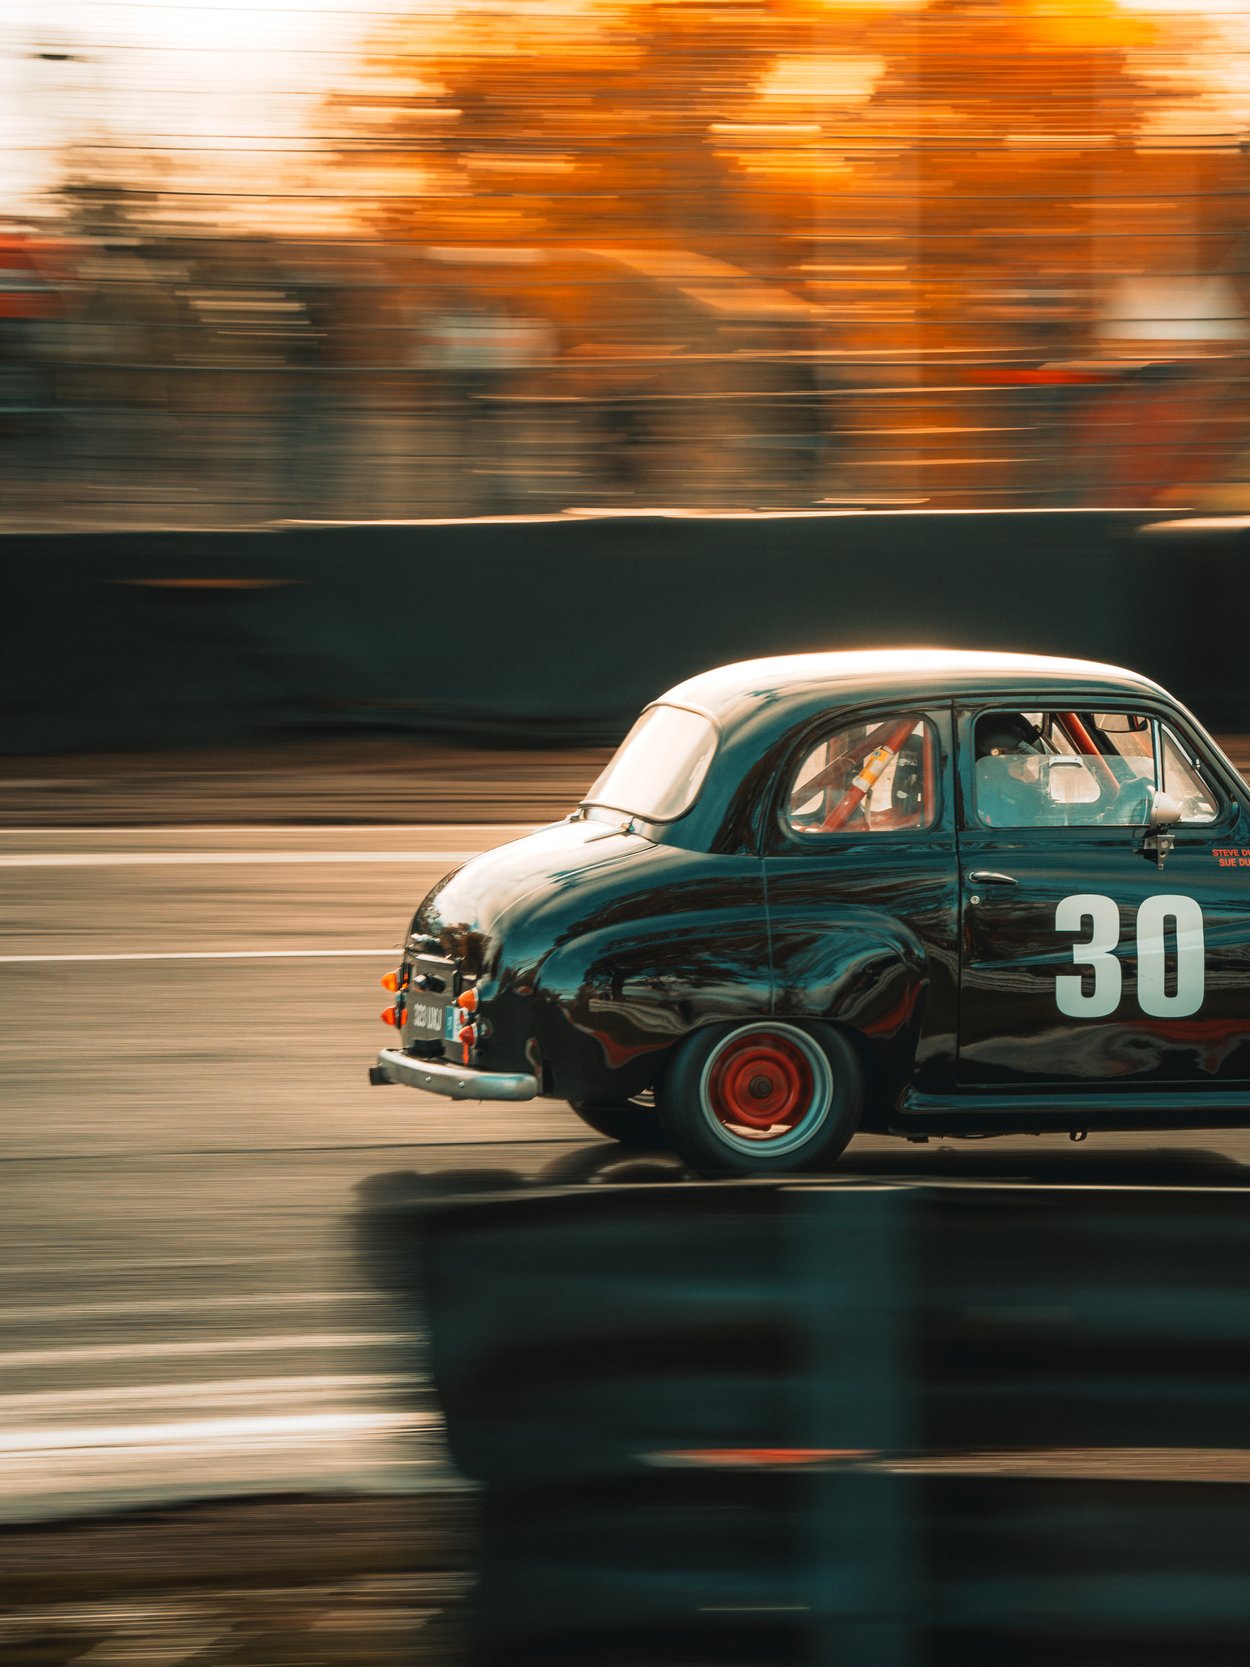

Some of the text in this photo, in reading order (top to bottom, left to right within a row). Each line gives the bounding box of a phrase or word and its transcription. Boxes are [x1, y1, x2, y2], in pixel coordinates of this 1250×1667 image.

[1212, 849, 1240, 857] STEVE
[1219, 858, 1237, 867] SUE
[1055, 894, 1205, 1018] 30
